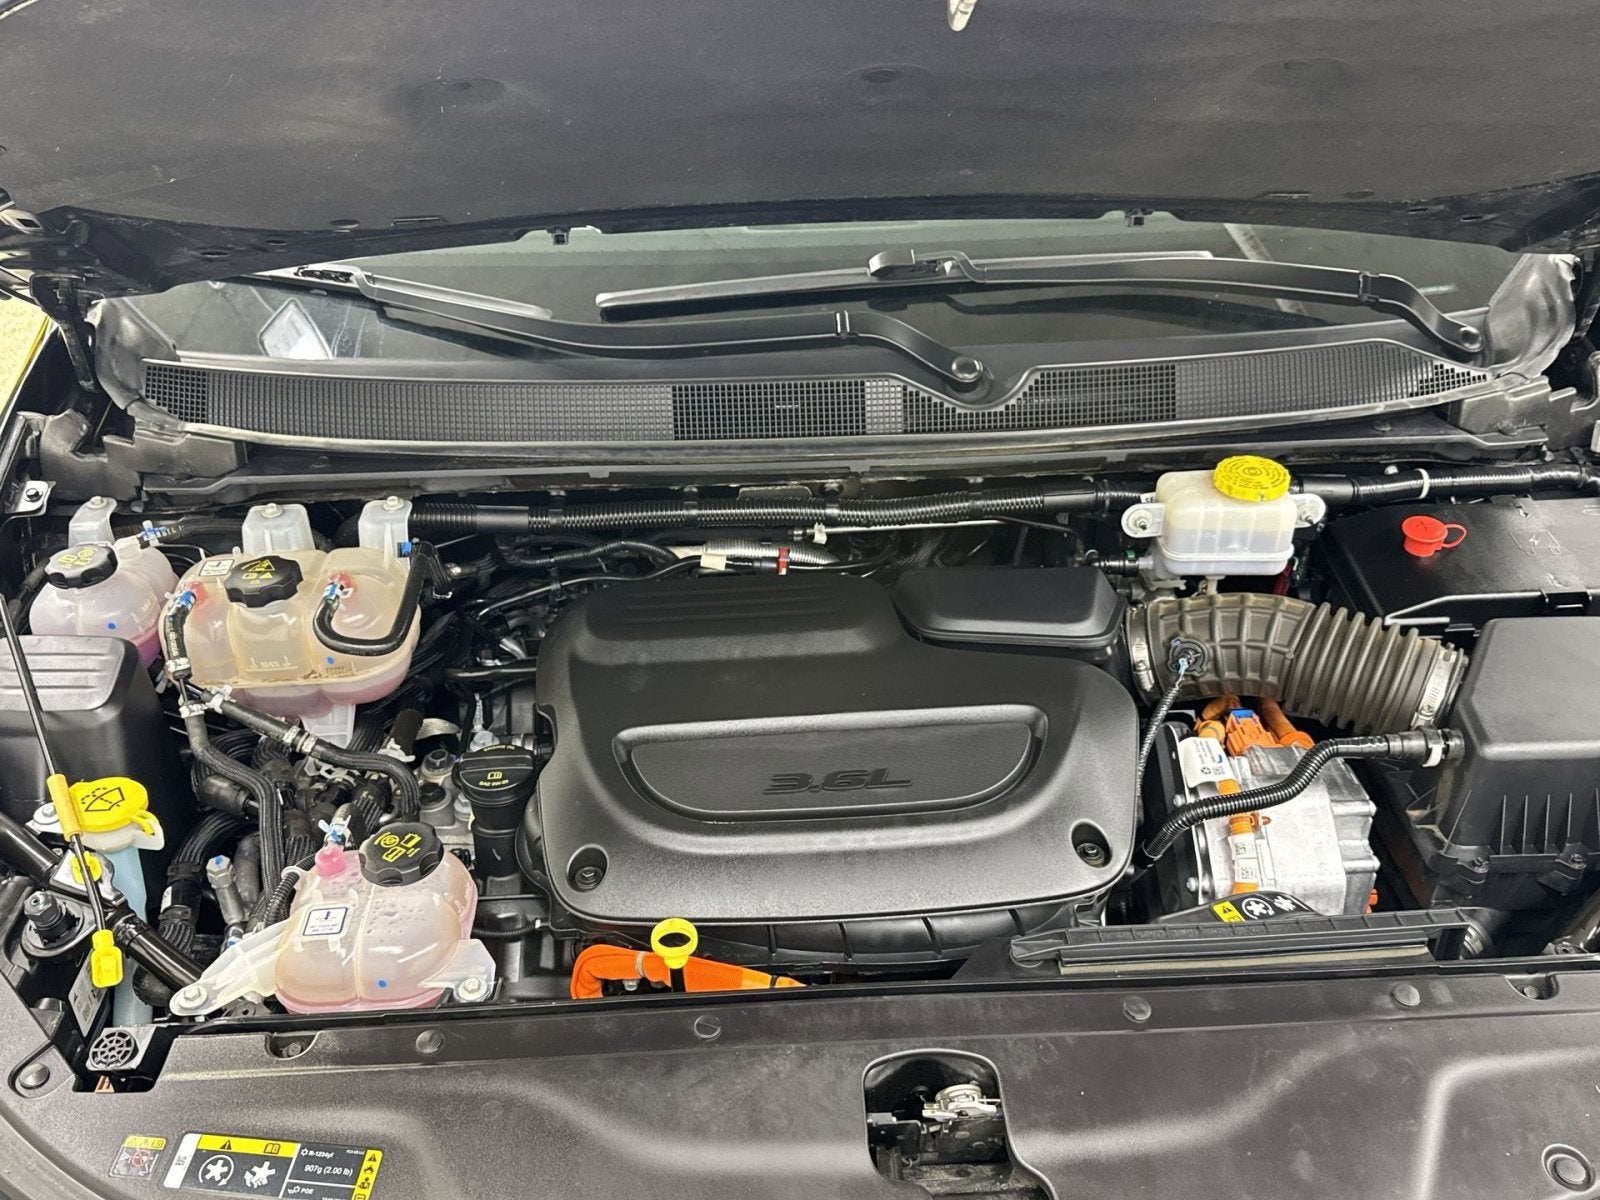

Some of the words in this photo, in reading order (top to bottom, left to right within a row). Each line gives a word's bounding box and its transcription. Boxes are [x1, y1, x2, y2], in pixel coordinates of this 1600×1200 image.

[763, 768, 913, 795] 3.6L
[308, 1150, 334, 1159] R-1234yf
[304, 1164, 323, 1175] 907g
[323, 1167, 342, 1175] (2.00
[343, 1168, 353, 1177] lb)
